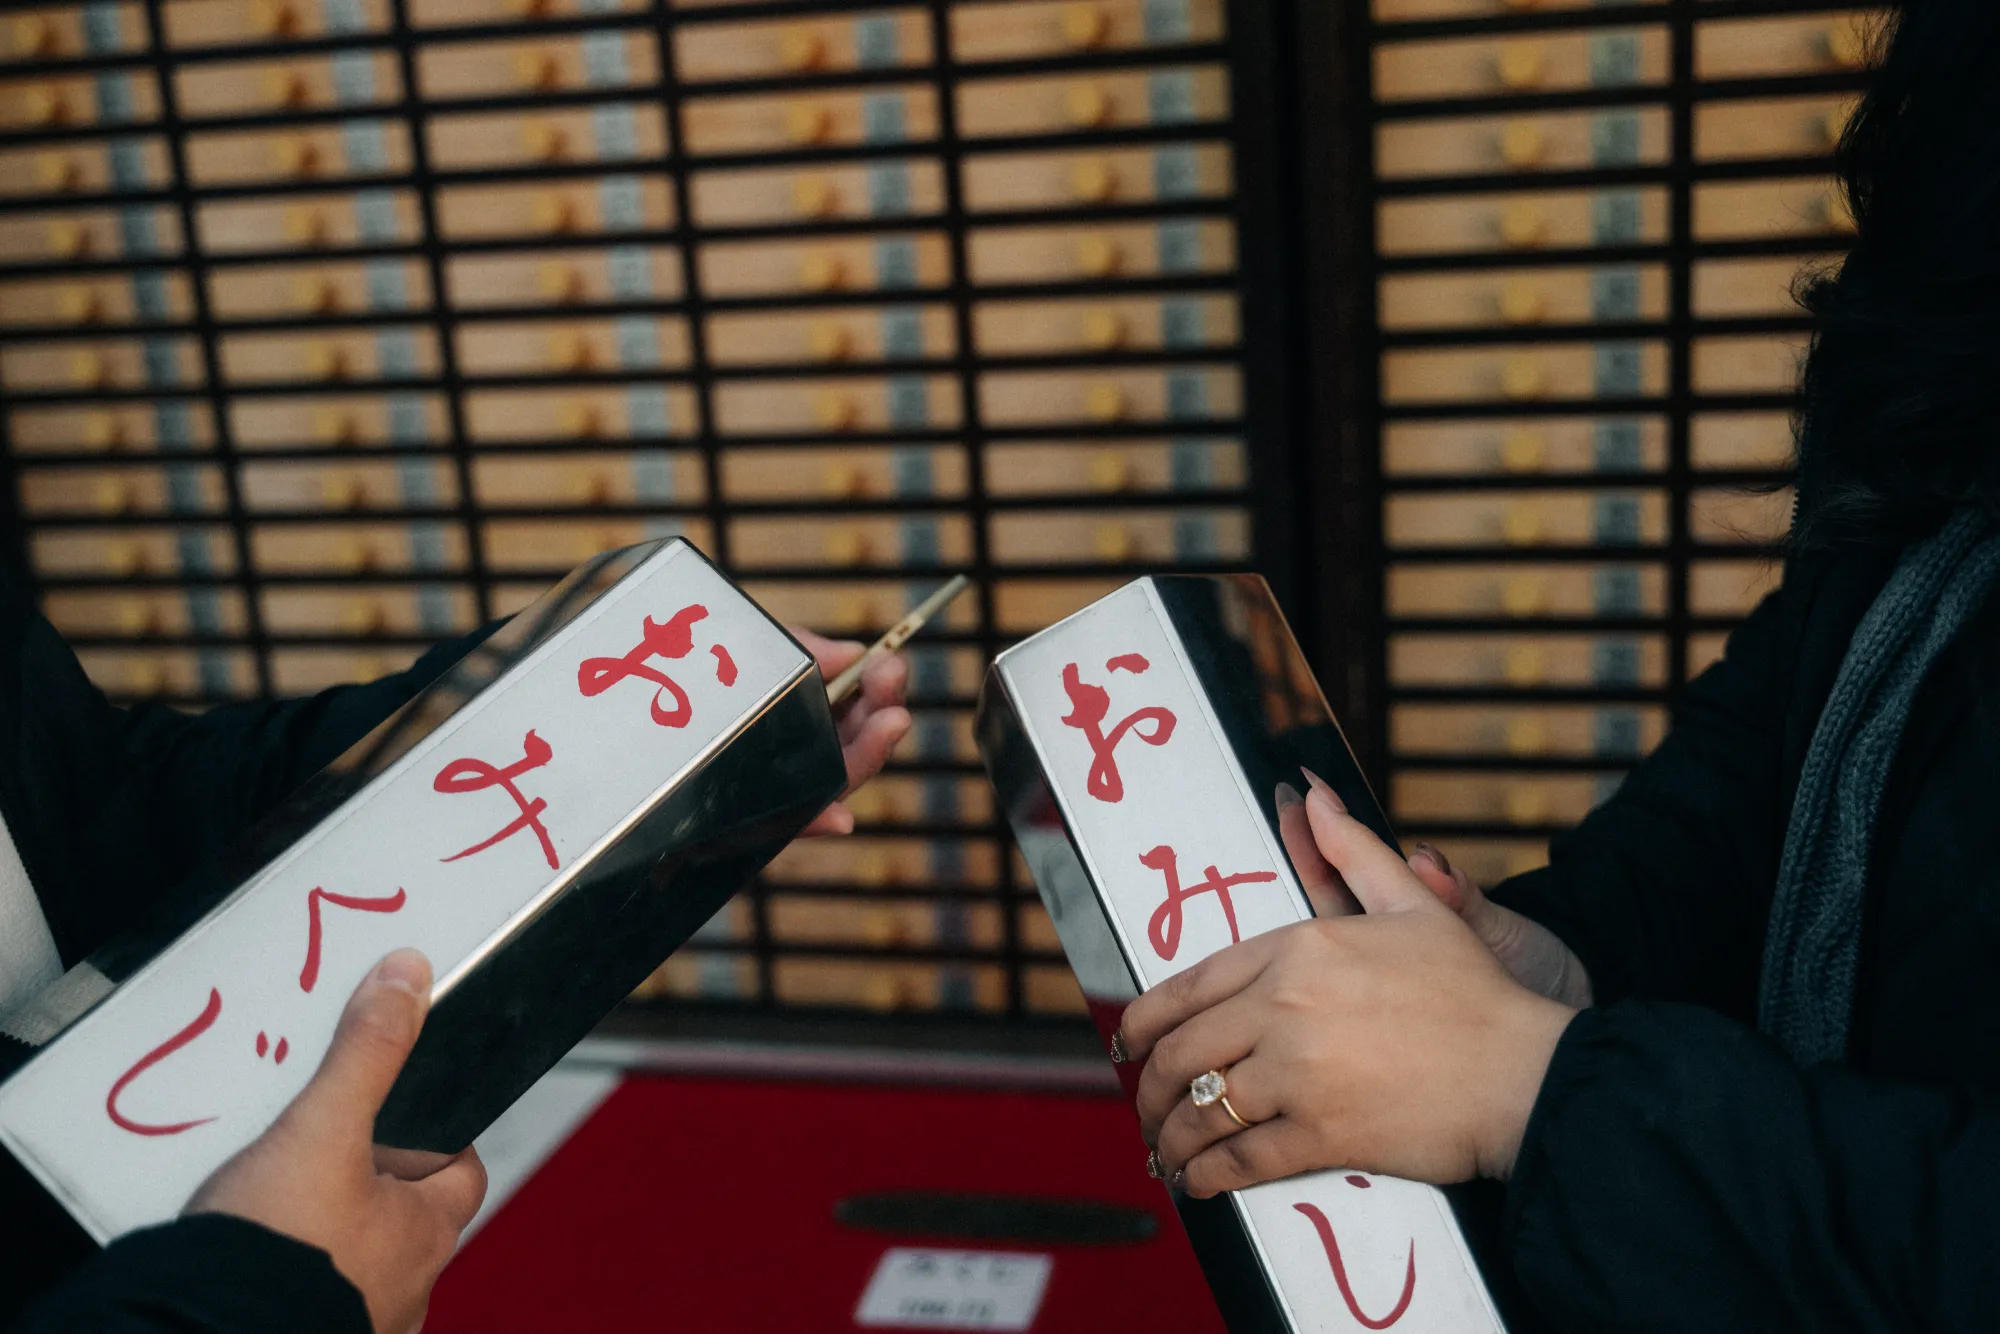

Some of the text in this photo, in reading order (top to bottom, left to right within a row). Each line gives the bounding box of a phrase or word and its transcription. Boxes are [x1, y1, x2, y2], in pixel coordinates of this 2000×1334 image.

[106, 604, 738, 1136] おみくじ
[1061, 652, 1416, 1330] おみじ
